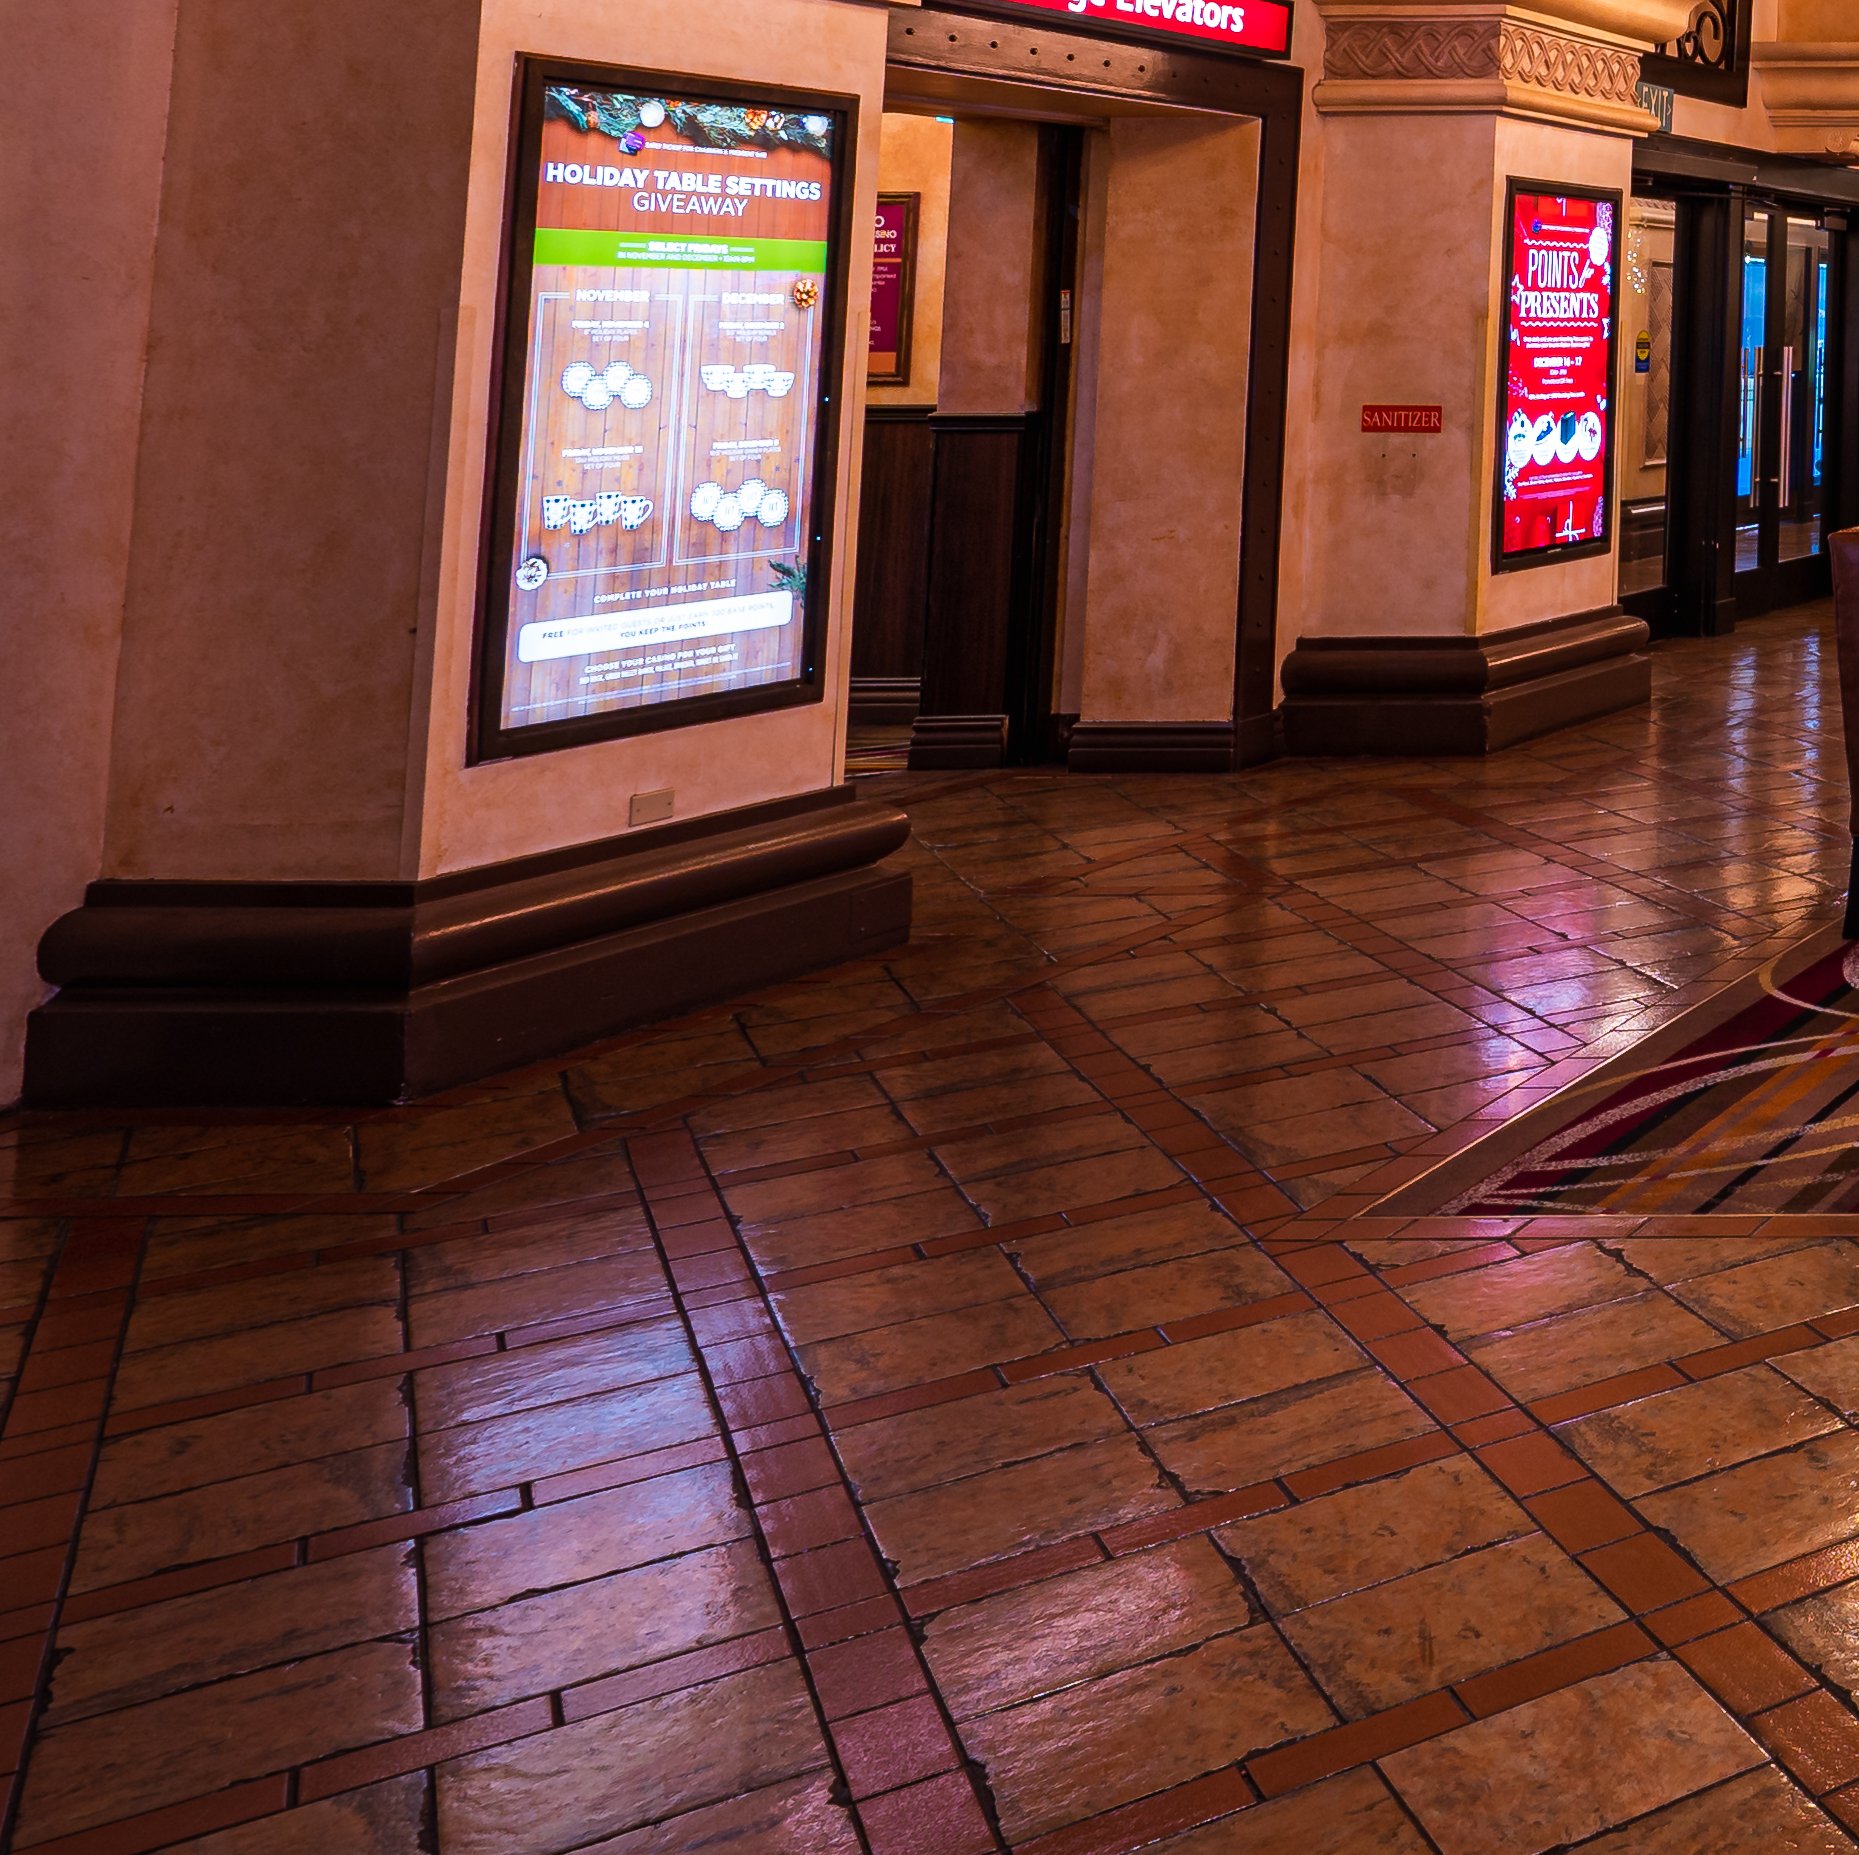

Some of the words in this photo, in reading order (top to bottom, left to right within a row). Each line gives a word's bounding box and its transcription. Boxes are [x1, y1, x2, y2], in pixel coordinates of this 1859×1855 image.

[1641, 85, 1668, 127] EXIT
[545, 162, 649, 188] HOLIDAY
[654, 171, 721, 193] TABLE
[725, 175, 821, 201] SETTINGS
[632, 192, 748, 217] GIVEAWAY
[647, 241, 688, 253] SELECT
[690, 242, 729, 254] FRIDAYS
[874, 243, 897, 253] LICY
[1527, 249, 1579, 289] POINTS
[575, 289, 650, 302] NOVEMBER
[721, 292, 785, 305] DECEMBER
[1519, 291, 1599, 319] PRESENTS
[1363, 411, 1440, 427] SANITIZER
[593, 590, 642, 604] COMPLETE
[645, 587, 669, 599] YOUR
[670, 582, 708, 596] HOLIDAY
[709, 579, 737, 590] TABLE
[542, 630, 564, 639] FREE
[620, 630, 636, 638] YOU
[639, 627, 659, 636] KEEP
[661, 625, 675, 633] THE
[584, 662, 618, 675] CHOOSE
[620, 658, 644, 670] YOUR
[645, 653, 676, 665] CASINO
[677, 650, 692, 661] FOR
[693, 647, 717, 658] YOUR
